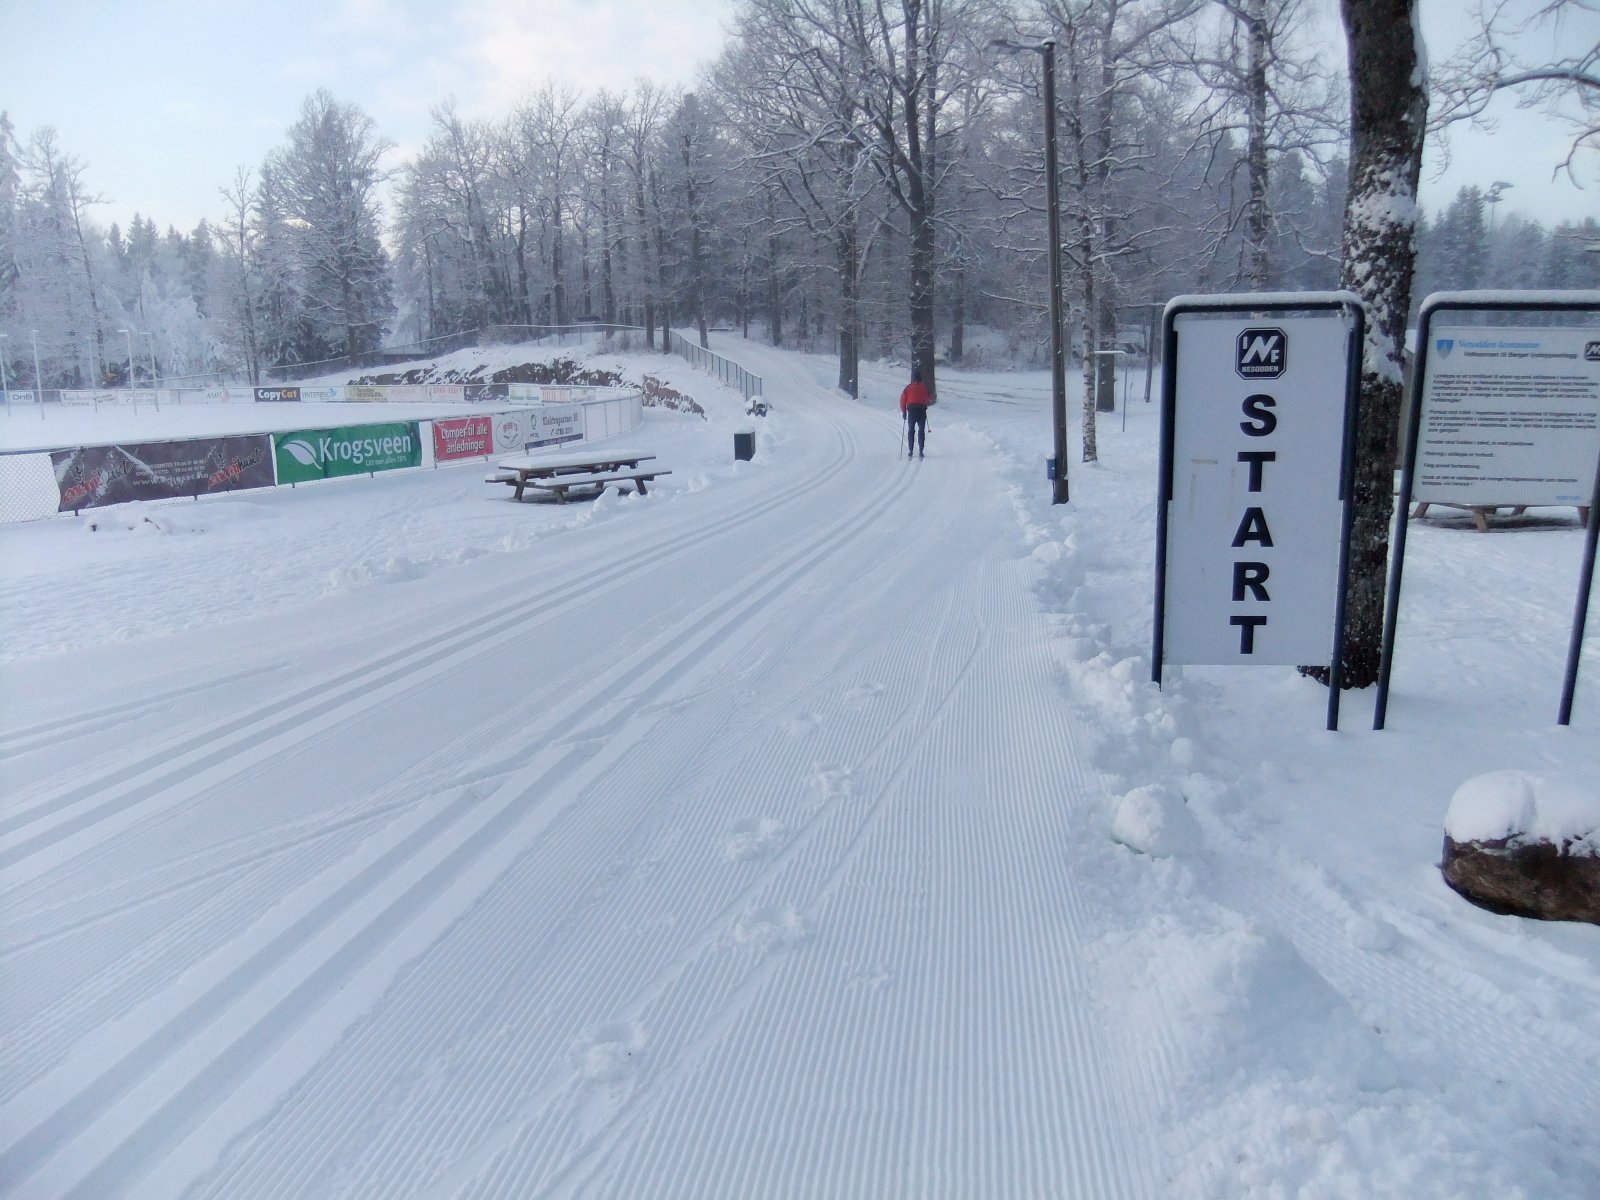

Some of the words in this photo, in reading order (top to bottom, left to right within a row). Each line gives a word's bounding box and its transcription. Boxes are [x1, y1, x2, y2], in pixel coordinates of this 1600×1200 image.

[1242, 365, 1279, 373] NESODDEN
[257, 388, 298, 401] CopyCat
[477, 424, 488, 435] alle
[319, 435, 412, 465] Krogsveen
[446, 439, 485, 454] anledninger
[1229, 393, 1278, 655] START
